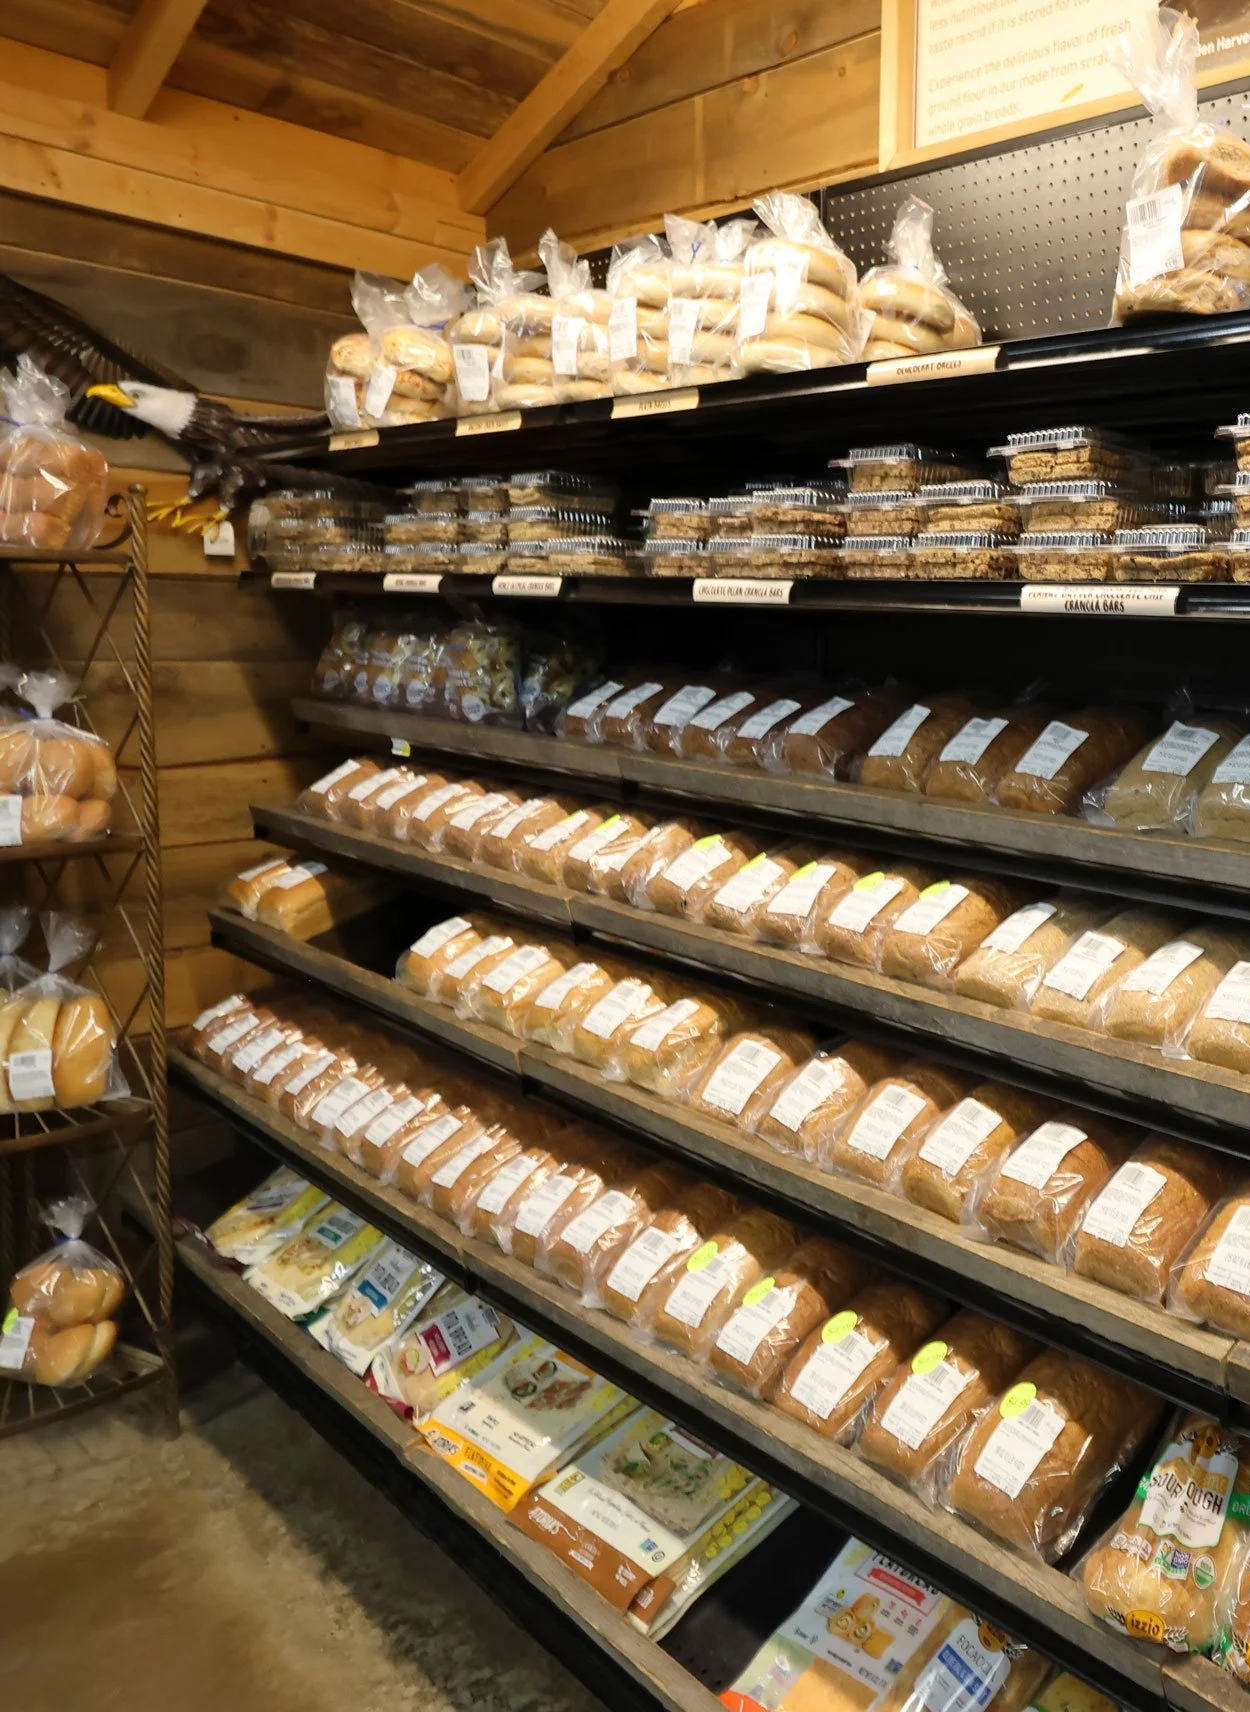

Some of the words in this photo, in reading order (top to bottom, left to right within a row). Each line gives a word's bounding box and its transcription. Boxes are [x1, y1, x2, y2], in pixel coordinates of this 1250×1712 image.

[928, 65, 983, 93] Experience
[984, 58, 1001, 74] the
[1002, 44, 1051, 70] delicious
[1053, 34, 1083, 53] flavor
[1086, 27, 1099, 44] of
[1100, 18, 1132, 40] fresh
[963, 87, 987, 105] flour
[1019, 71, 1049, 89] made
[1051, 60, 1078, 79] from
[1064, 599, 1101, 613] GRANOLA
[1103, 600, 1126, 613] BARS
[1130, 1613, 1161, 1637] izzio
